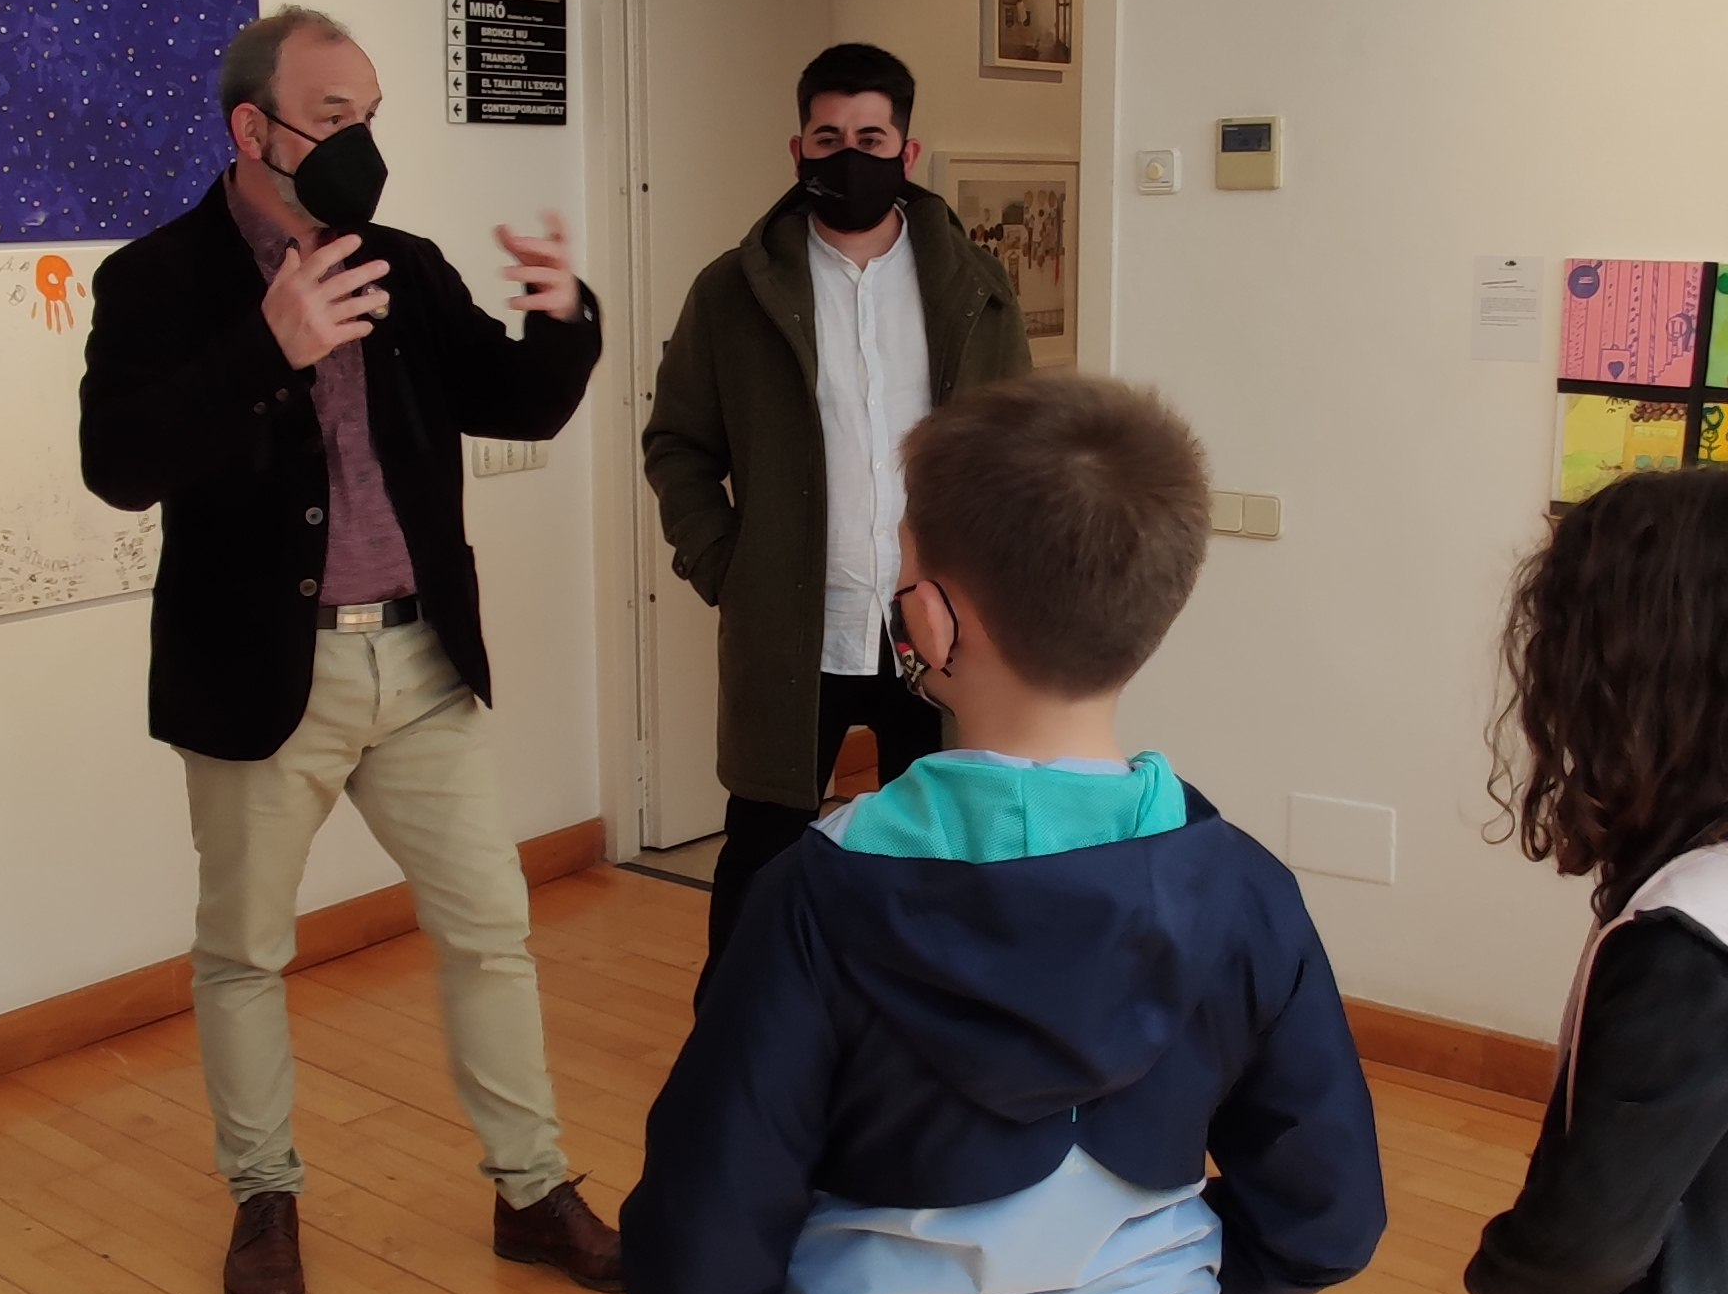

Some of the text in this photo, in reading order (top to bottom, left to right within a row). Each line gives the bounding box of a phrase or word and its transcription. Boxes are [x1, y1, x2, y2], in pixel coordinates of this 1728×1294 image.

[469, 1, 506, 19] MIRÓ
[481, 27, 528, 40] BRONZE NU
[481, 52, 525, 64] TRANSICIÓ
[481, 78, 492, 88] EL
[493, 79, 522, 89] TALLER
